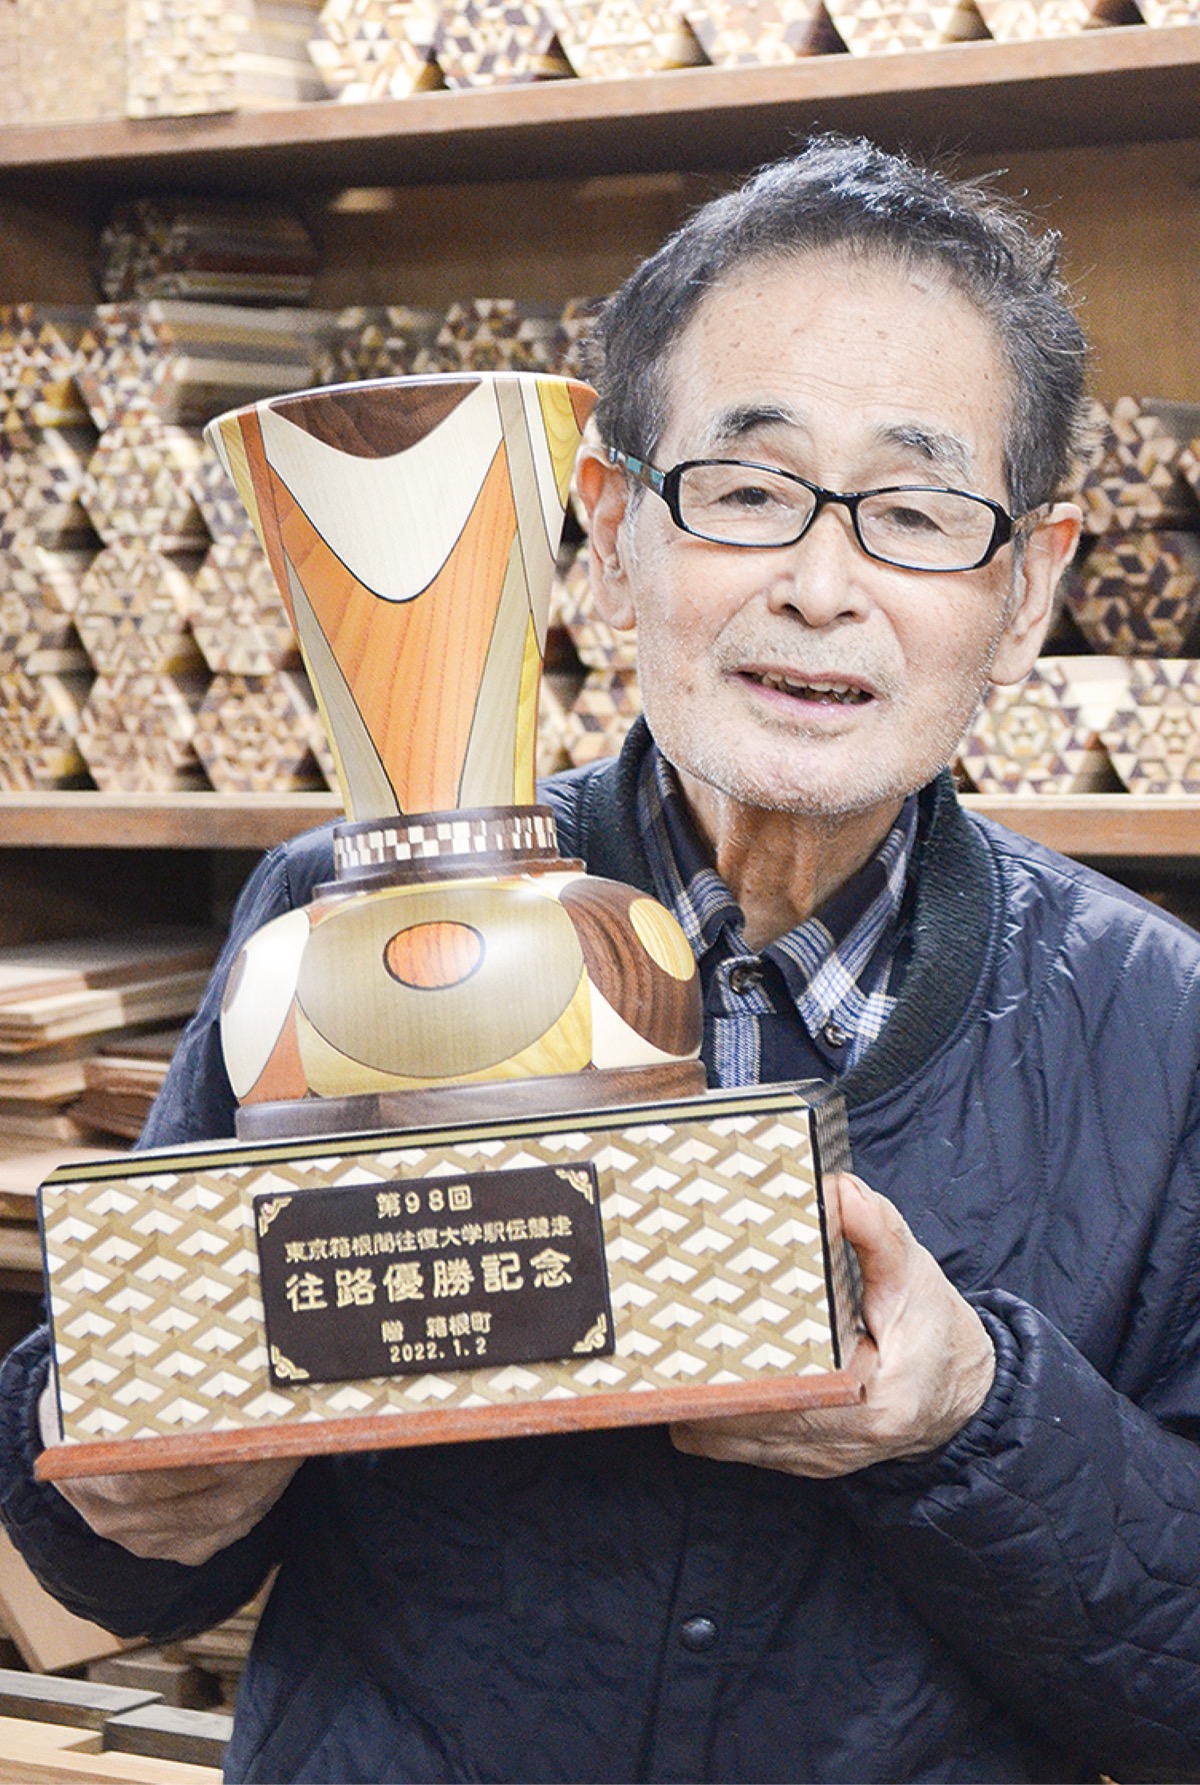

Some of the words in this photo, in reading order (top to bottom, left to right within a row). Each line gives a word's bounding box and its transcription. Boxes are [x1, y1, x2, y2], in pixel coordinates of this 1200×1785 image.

[376, 1184, 473, 1219] 第98回
[285, 1248, 573, 1313] 往路優勝記念
[426, 1312, 492, 1339] 箱根町
